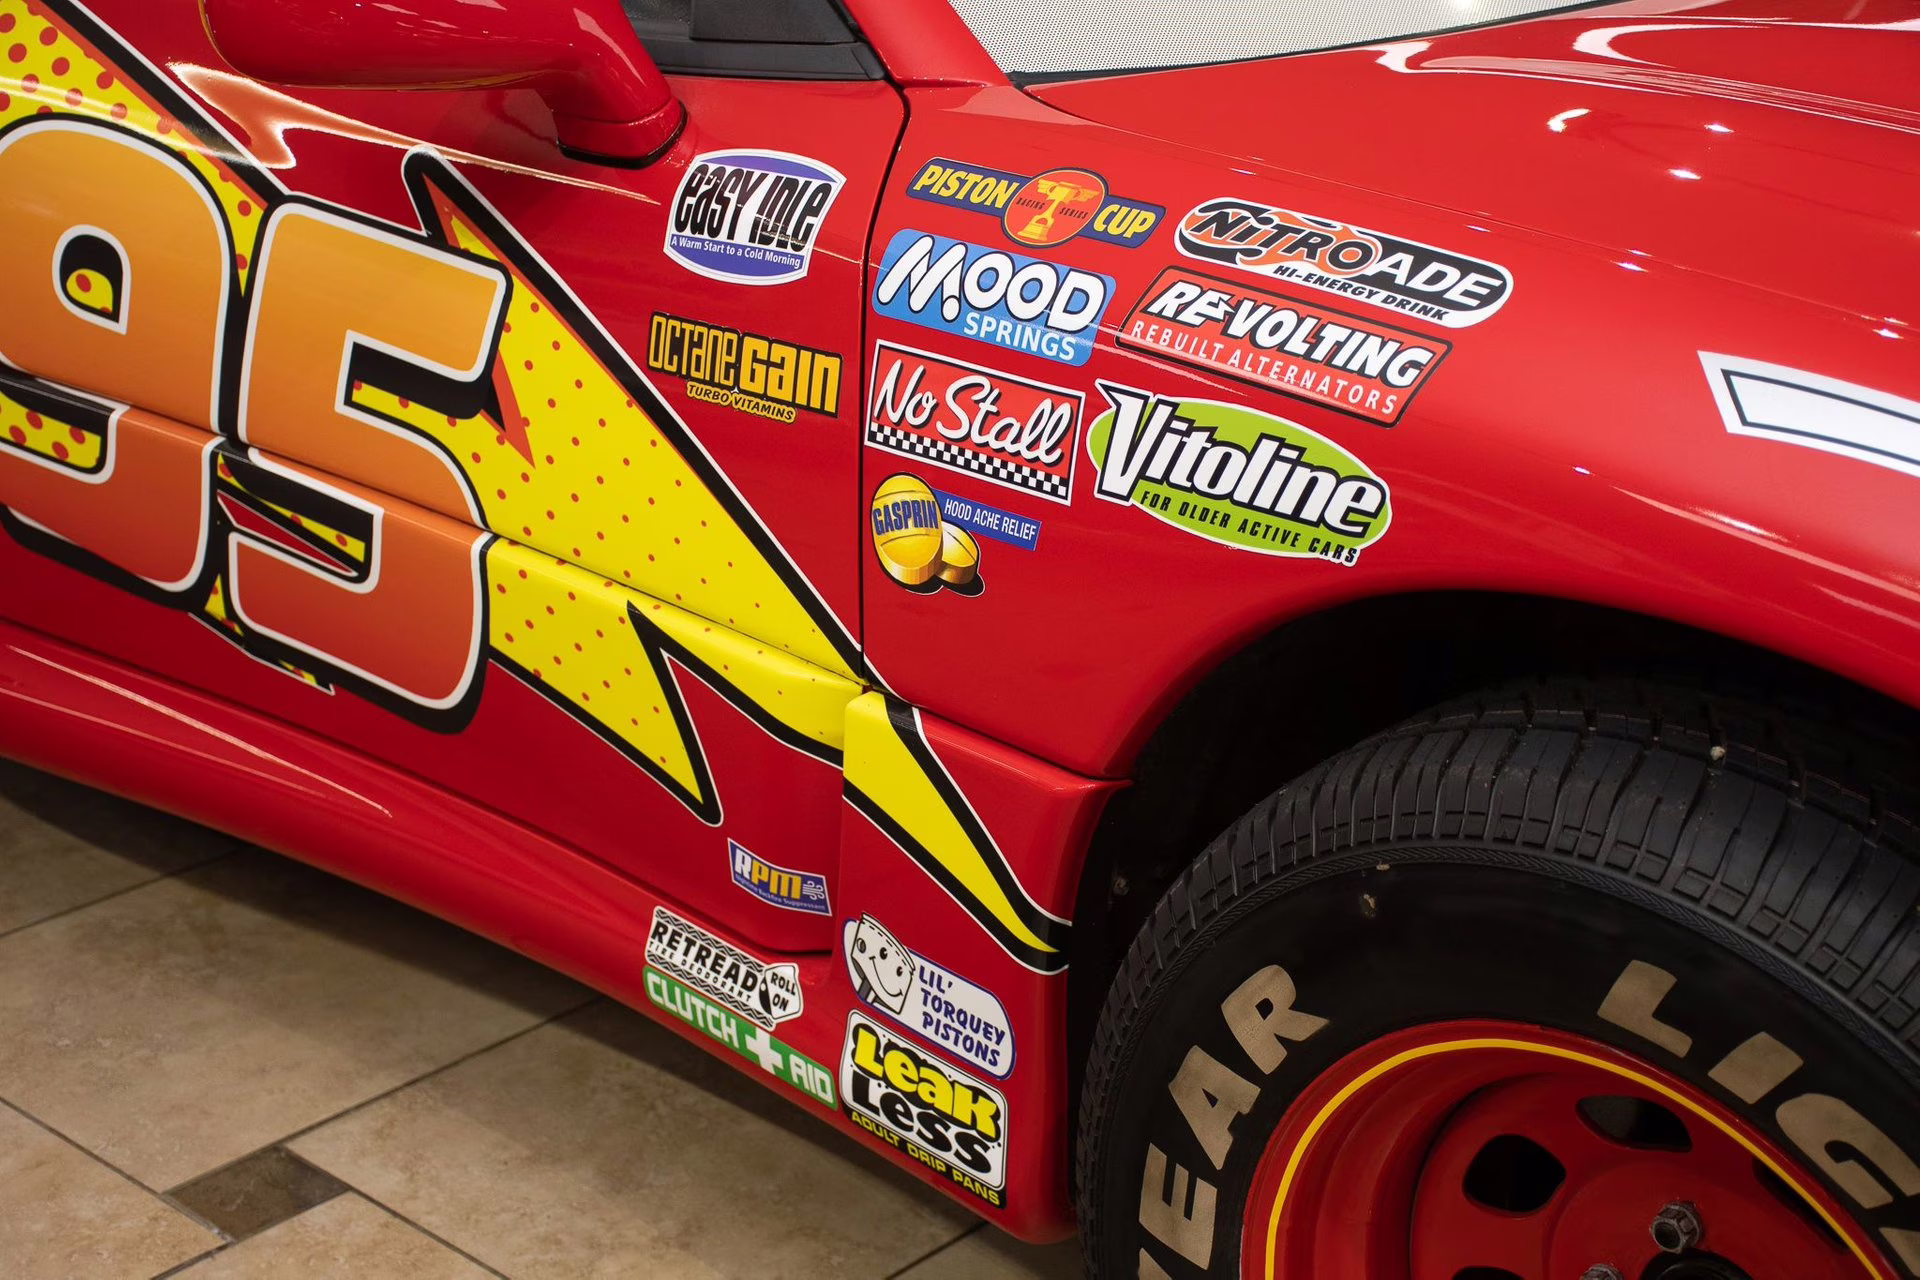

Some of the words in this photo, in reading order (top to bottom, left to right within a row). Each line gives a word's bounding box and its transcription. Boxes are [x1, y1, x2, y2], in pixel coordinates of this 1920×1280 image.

[913, 164, 1020, 209] PISTON
[1093, 204, 1156, 238] CUP
[1016, 197, 1045, 210] RACING
[1059, 206, 1089, 220] SERIES
[671, 236, 678, 246] A
[679, 238, 702, 249] Warm
[703, 240, 725, 253] Start
[726, 244, 736, 255] to
[737, 248, 743, 256] a
[744, 247, 763, 260] Cold
[765, 251, 801, 269] Morning
[876, 234, 1107, 334] MOOD
[1273, 265, 1379, 300] HI-ENERGY
[1382, 294, 1449, 321] DRINK
[963, 312, 1077, 361] SPRINGS
[1130, 320, 1223, 360] REBUILT
[1227, 344, 1399, 414] ALTERNATORS
[0, 117, 508, 713] 95
[688, 384, 729, 403] TURBO
[733, 393, 794, 421] VITAMINS
[873, 359, 938, 426] No
[936, 375, 1072, 466] Stall
[1097, 383, 1386, 537] Vitoline
[872, 500, 939, 536] GASPRIN
[944, 498, 971, 521] HOOD
[973, 506, 1000, 529] ACHE
[1001, 516, 1037, 541] RELIEF
[1140, 491, 1171, 512] FOR
[1178, 501, 1231, 528] OLDER
[1237, 518, 1301, 548] ACTIVE
[1307, 537, 1358, 564] CARS
[649, 941, 674, 960] TIRE
[681, 959, 751, 1002] DEODORANT
[651, 921, 758, 992] RETREAD
[770, 972, 796, 996] ROLL
[919, 965, 953, 994] LIL'
[772, 994, 789, 1012] ON
[921, 988, 1005, 1046] TORQUEY
[647, 972, 740, 1048] CLUTCH
[789, 1054, 833, 1104] AID
[922, 1012, 1000, 1067] PISTONS
[1138, 964, 1330, 1280] EAR
[1597, 959, 1920, 1280] LIG
[851, 1111, 900, 1147] ADULT
[908, 1143, 947, 1174] DRIP
[952, 1166, 1000, 1206] PANS
